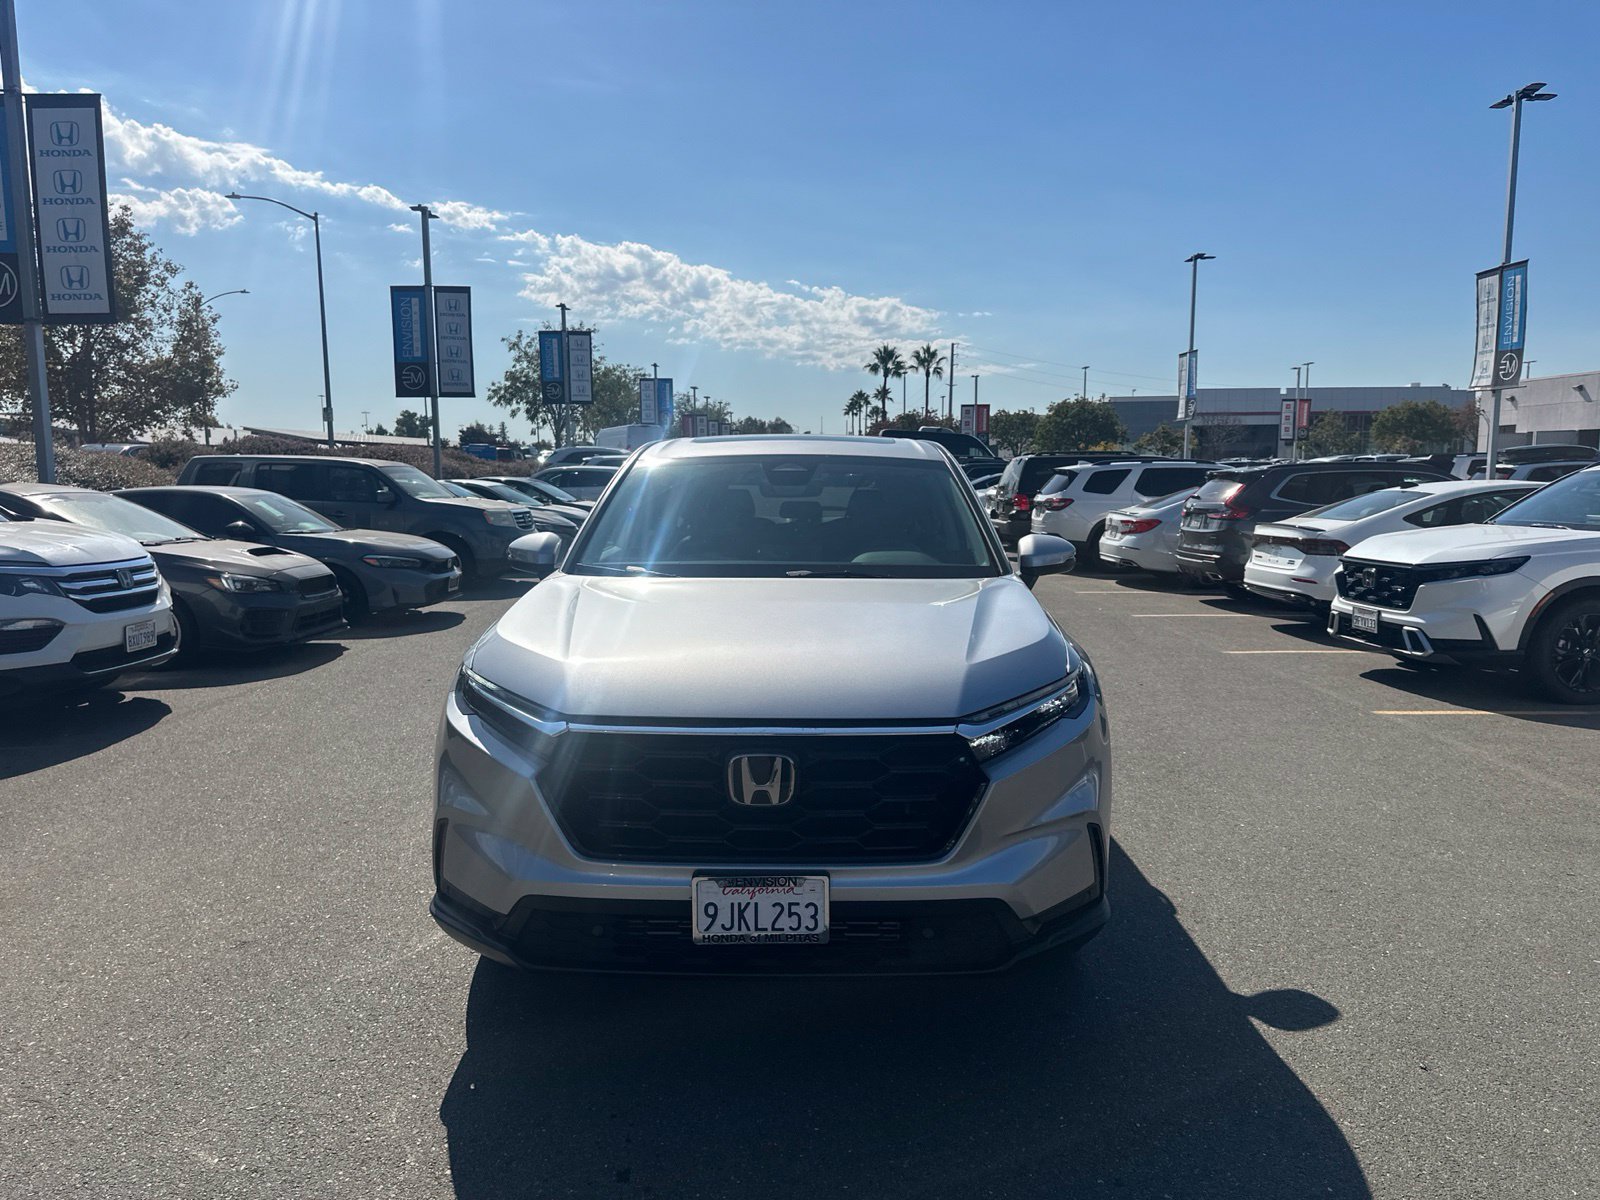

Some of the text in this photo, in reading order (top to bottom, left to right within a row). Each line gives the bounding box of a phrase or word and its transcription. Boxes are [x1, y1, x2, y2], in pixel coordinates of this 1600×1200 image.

[39, 149, 93, 158] HONDA
[42, 197, 96, 206] HONDA
[45, 245, 100, 254] HONDA
[50, 293, 104, 301] HONDA
[1503, 275, 1515, 345] ENVISION
[400, 297, 413, 358] ENVISION
[734, 877, 798, 887] ENVISION
[722, 885, 803, 900] California
[703, 901, 819, 932] 9JKL253
[702, 933, 820, 943] HONDA of MILPITAS
